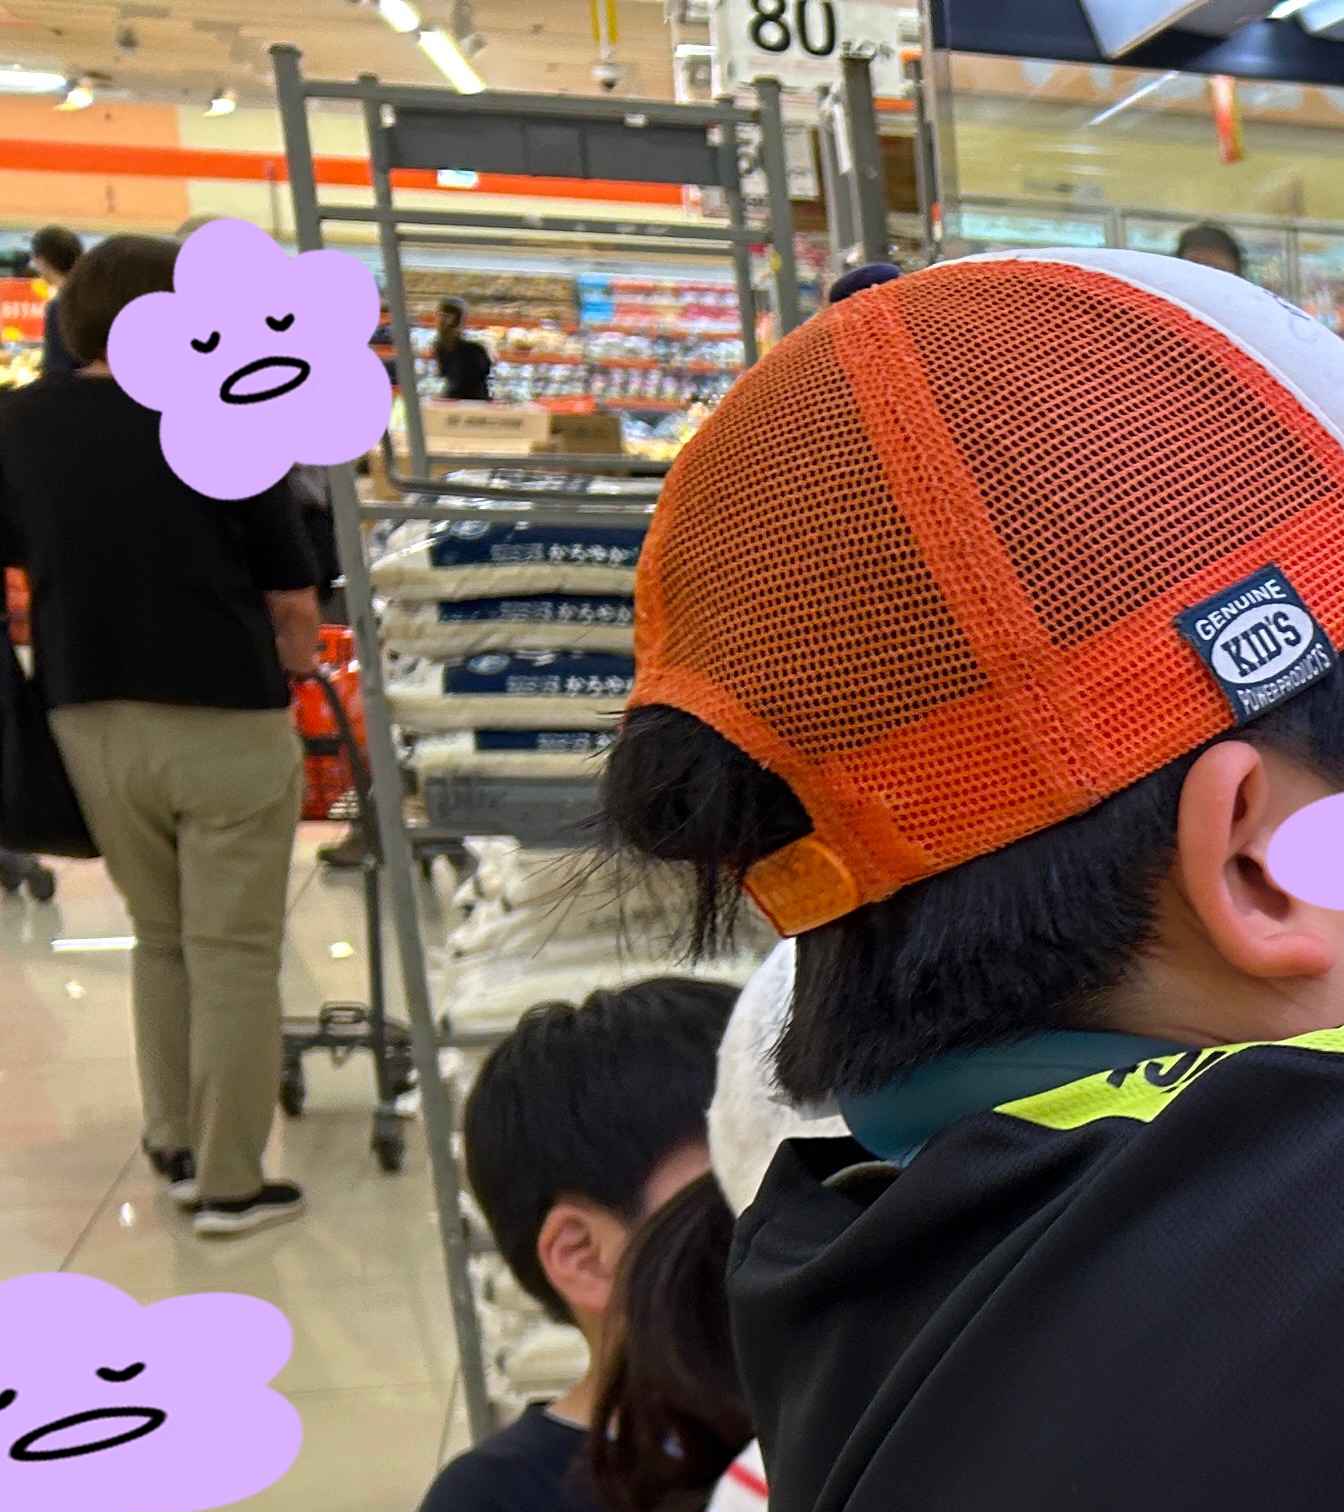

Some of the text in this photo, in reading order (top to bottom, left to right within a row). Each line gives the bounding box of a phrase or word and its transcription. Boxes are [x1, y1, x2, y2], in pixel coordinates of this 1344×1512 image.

[750, 0, 836, 56] 80
[1195, 579, 1287, 641] GENUINE
[1220, 611, 1302, 678] KID'S
